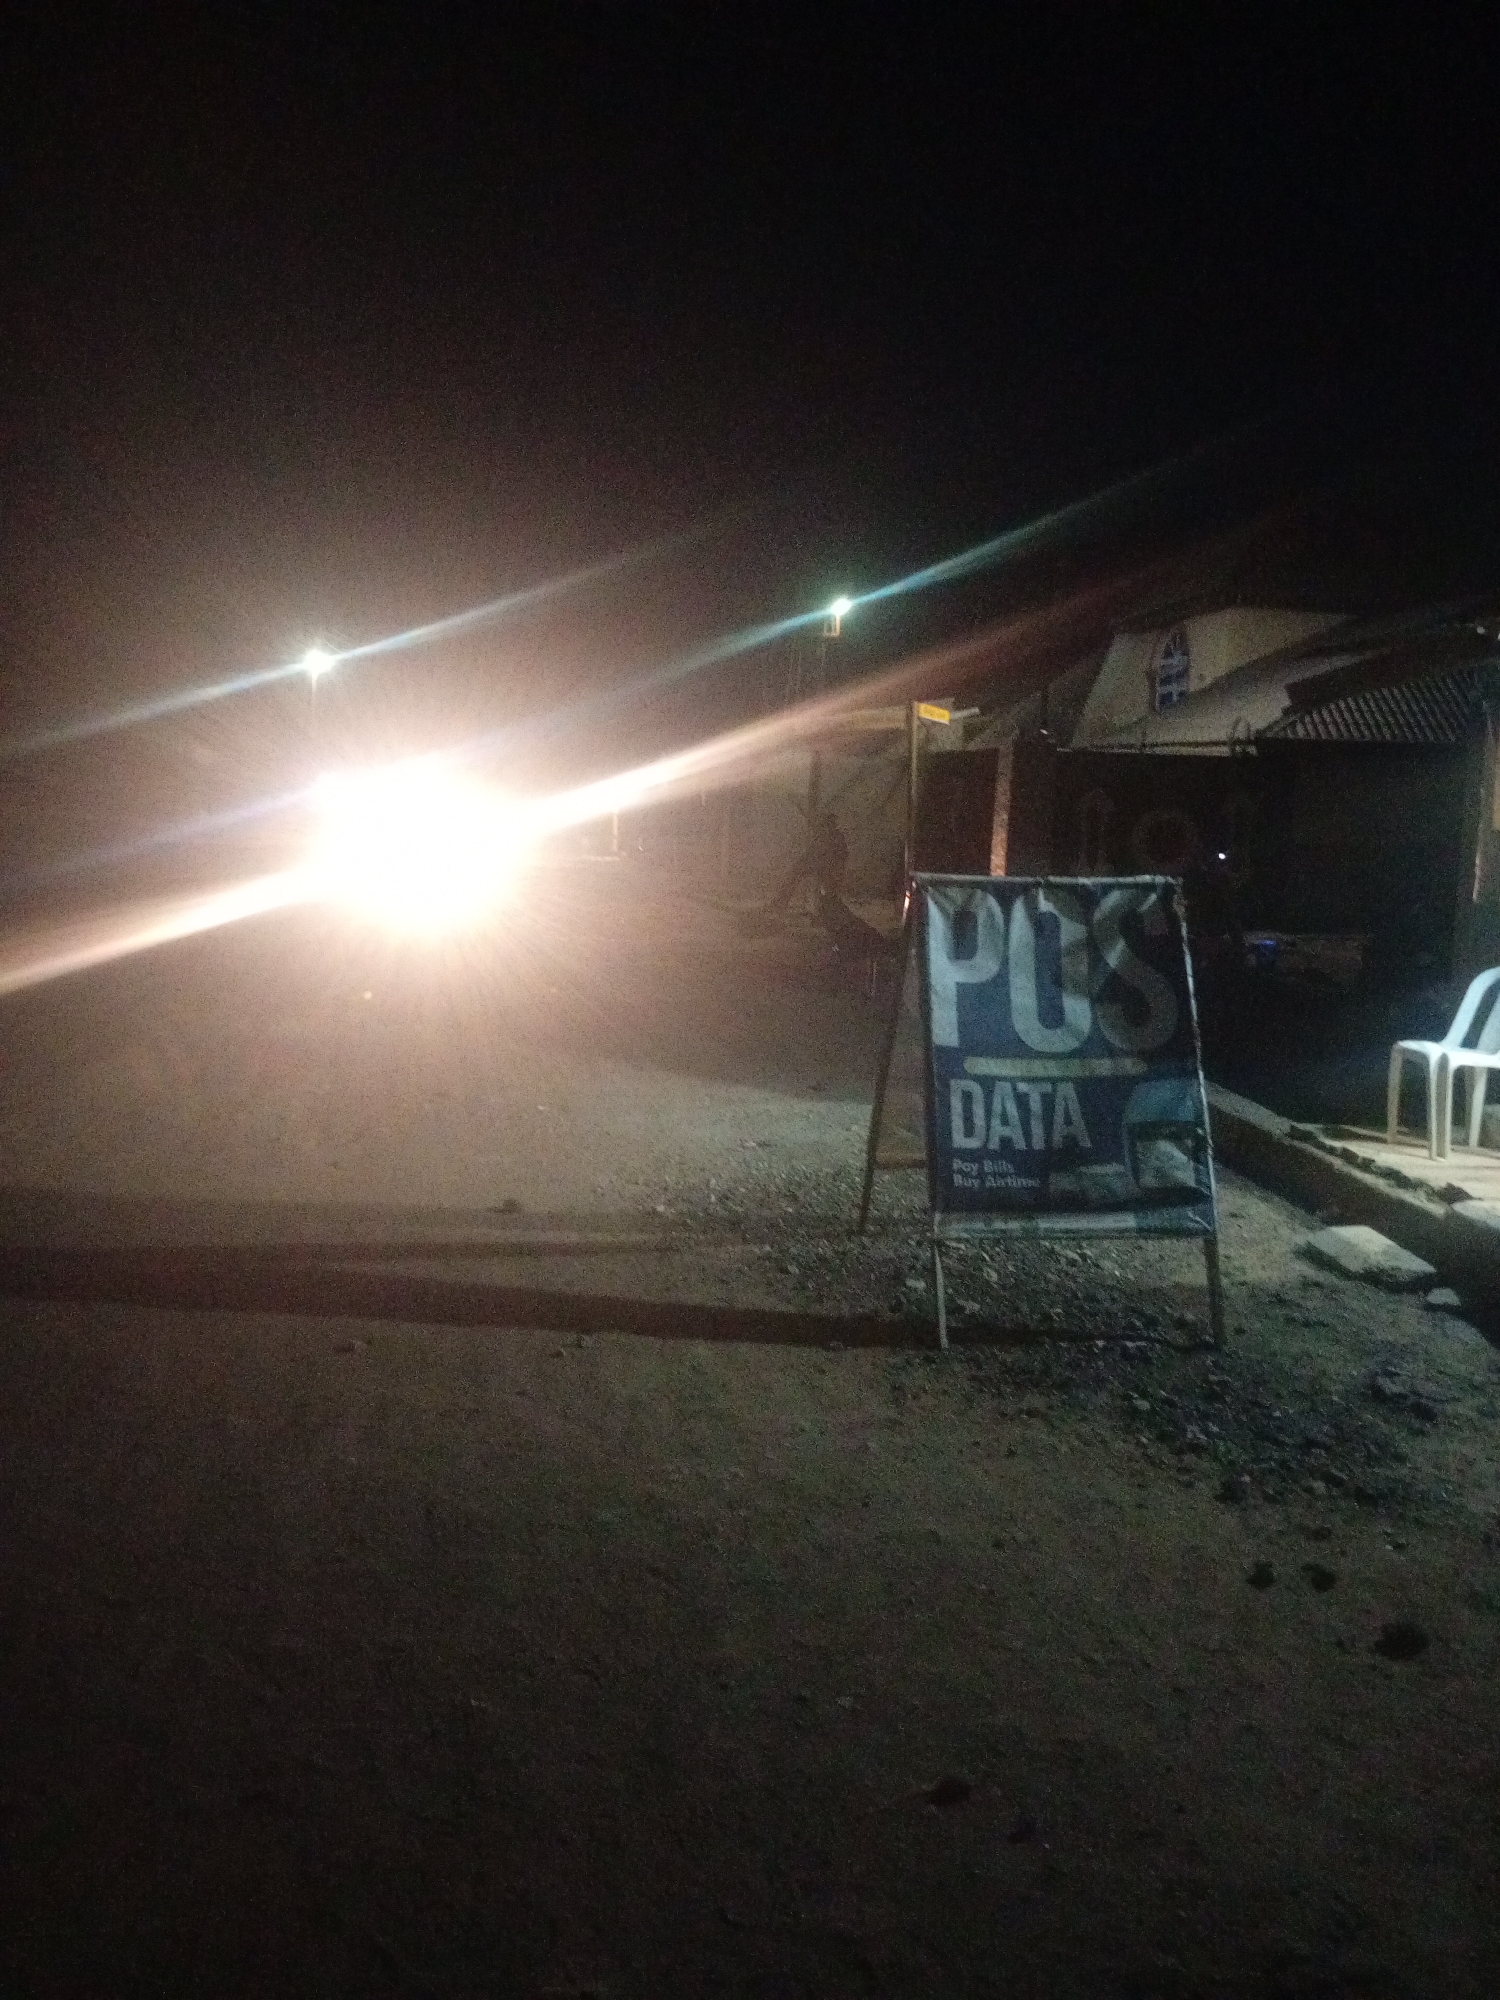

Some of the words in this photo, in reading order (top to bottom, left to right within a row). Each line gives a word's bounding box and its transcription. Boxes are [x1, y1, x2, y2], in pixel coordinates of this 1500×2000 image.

[927, 886, 1178, 1053] POS
[949, 1078, 1093, 1151] DATA
[952, 1173, 980, 1191] Buy
[983, 1159, 1015, 1174] Bills
